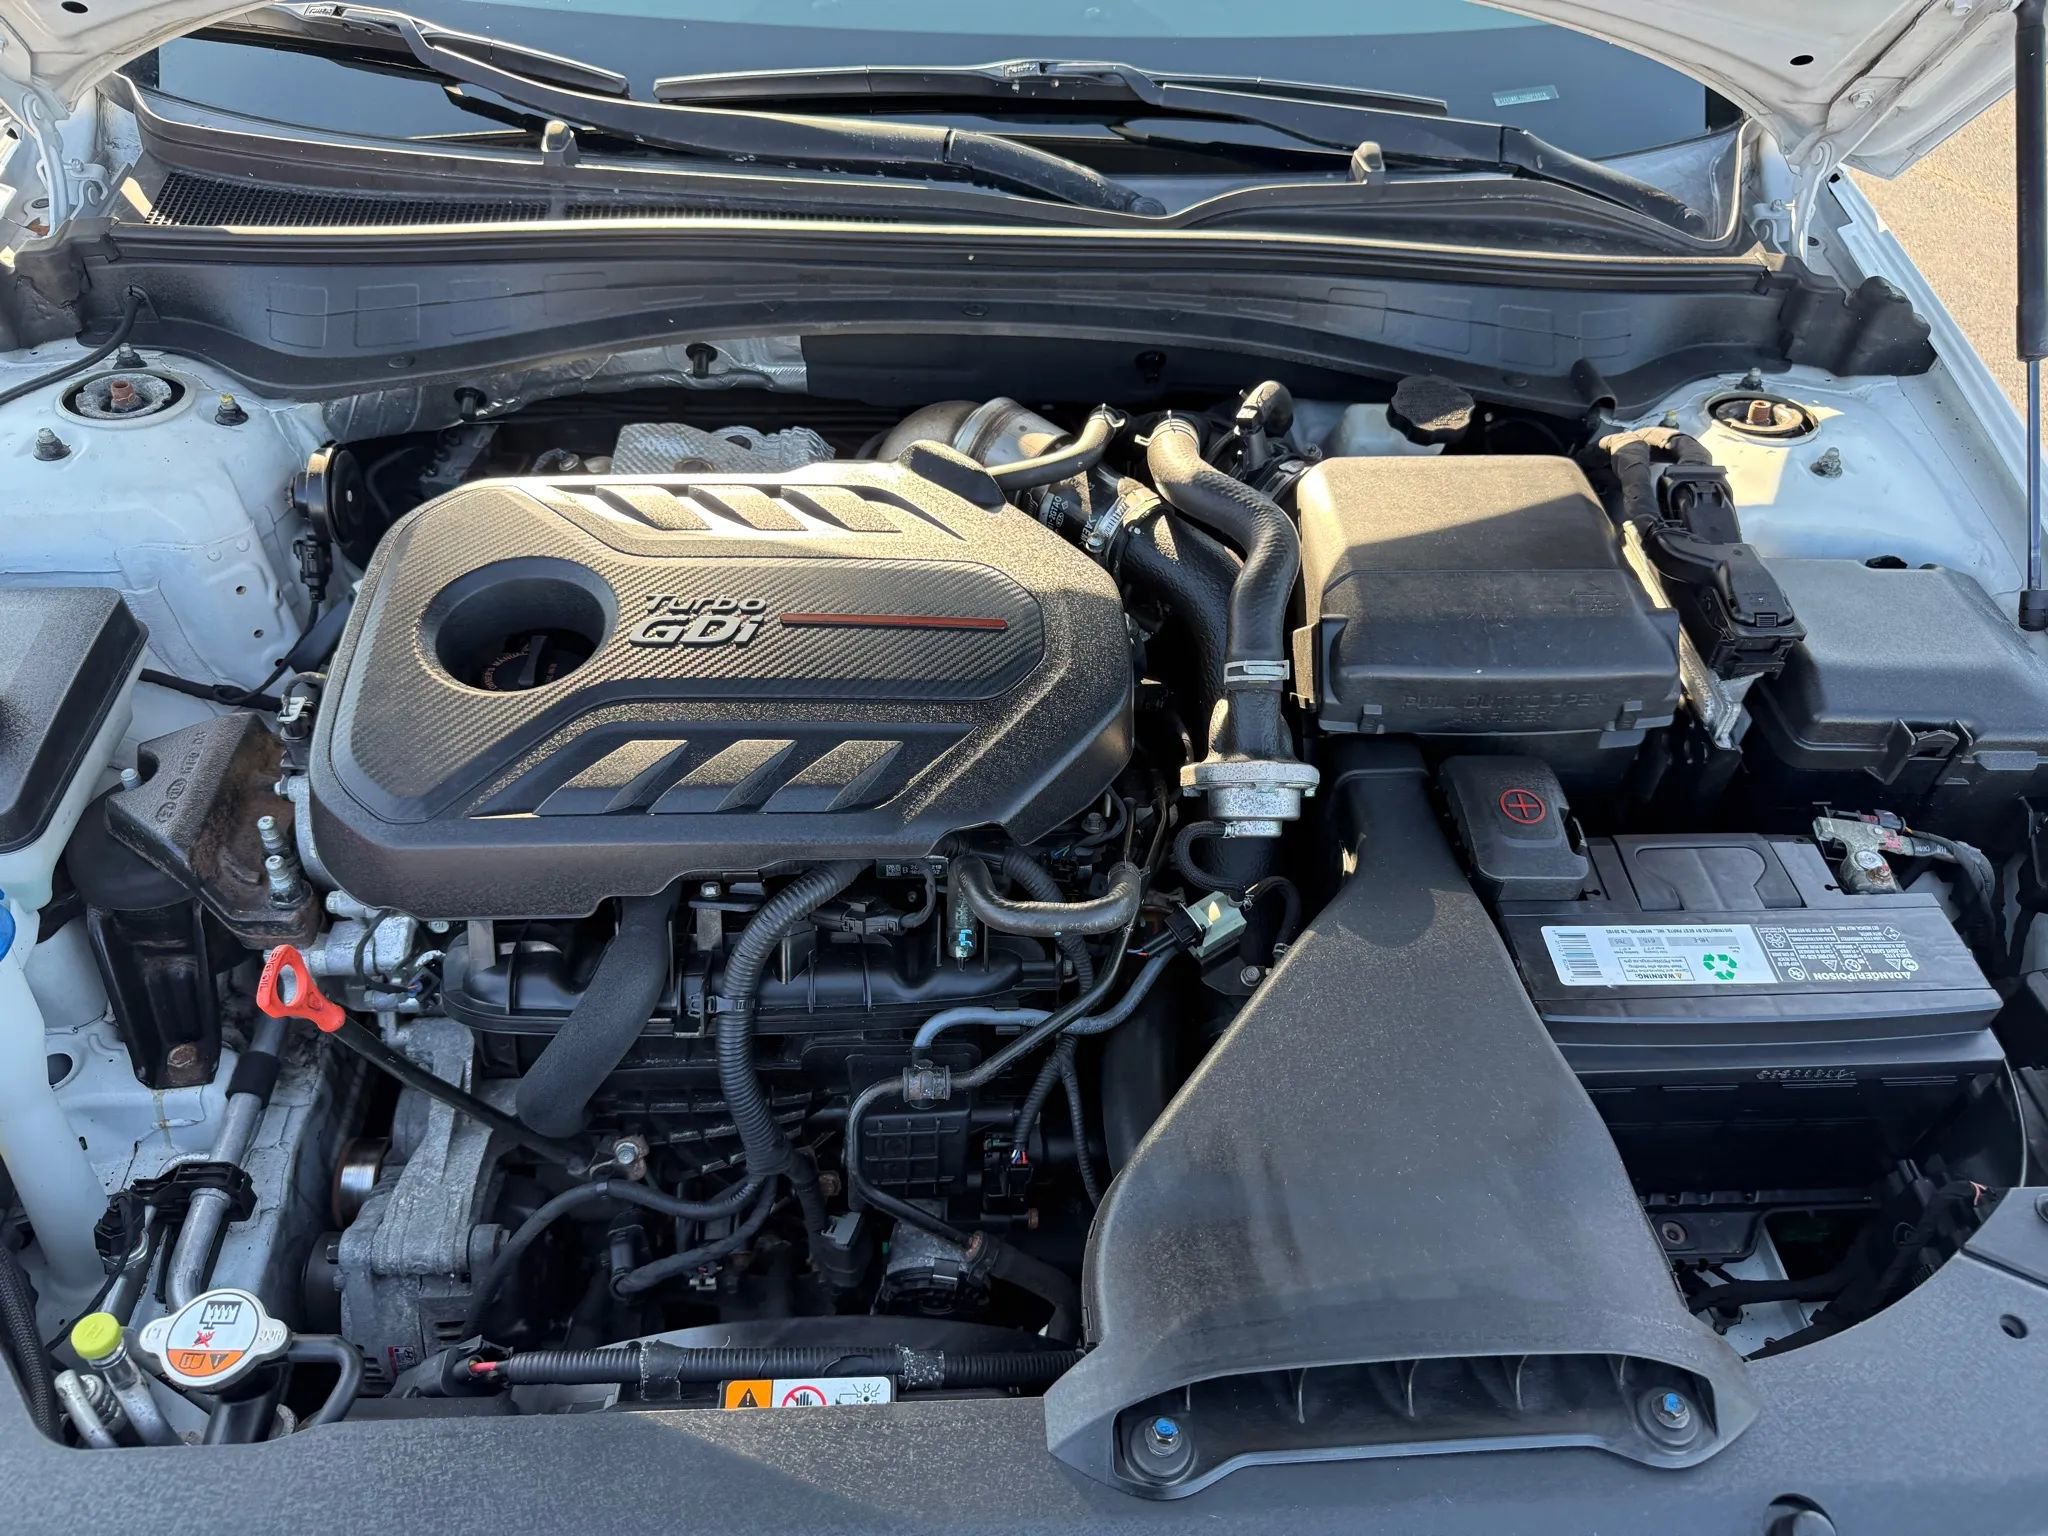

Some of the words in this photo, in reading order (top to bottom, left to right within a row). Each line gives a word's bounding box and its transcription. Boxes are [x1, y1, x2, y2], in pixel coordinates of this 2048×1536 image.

[645, 593, 767, 615] Turbo
[628, 614, 765, 649] GDi
[1812, 971, 1903, 980] DANGER/POISON
